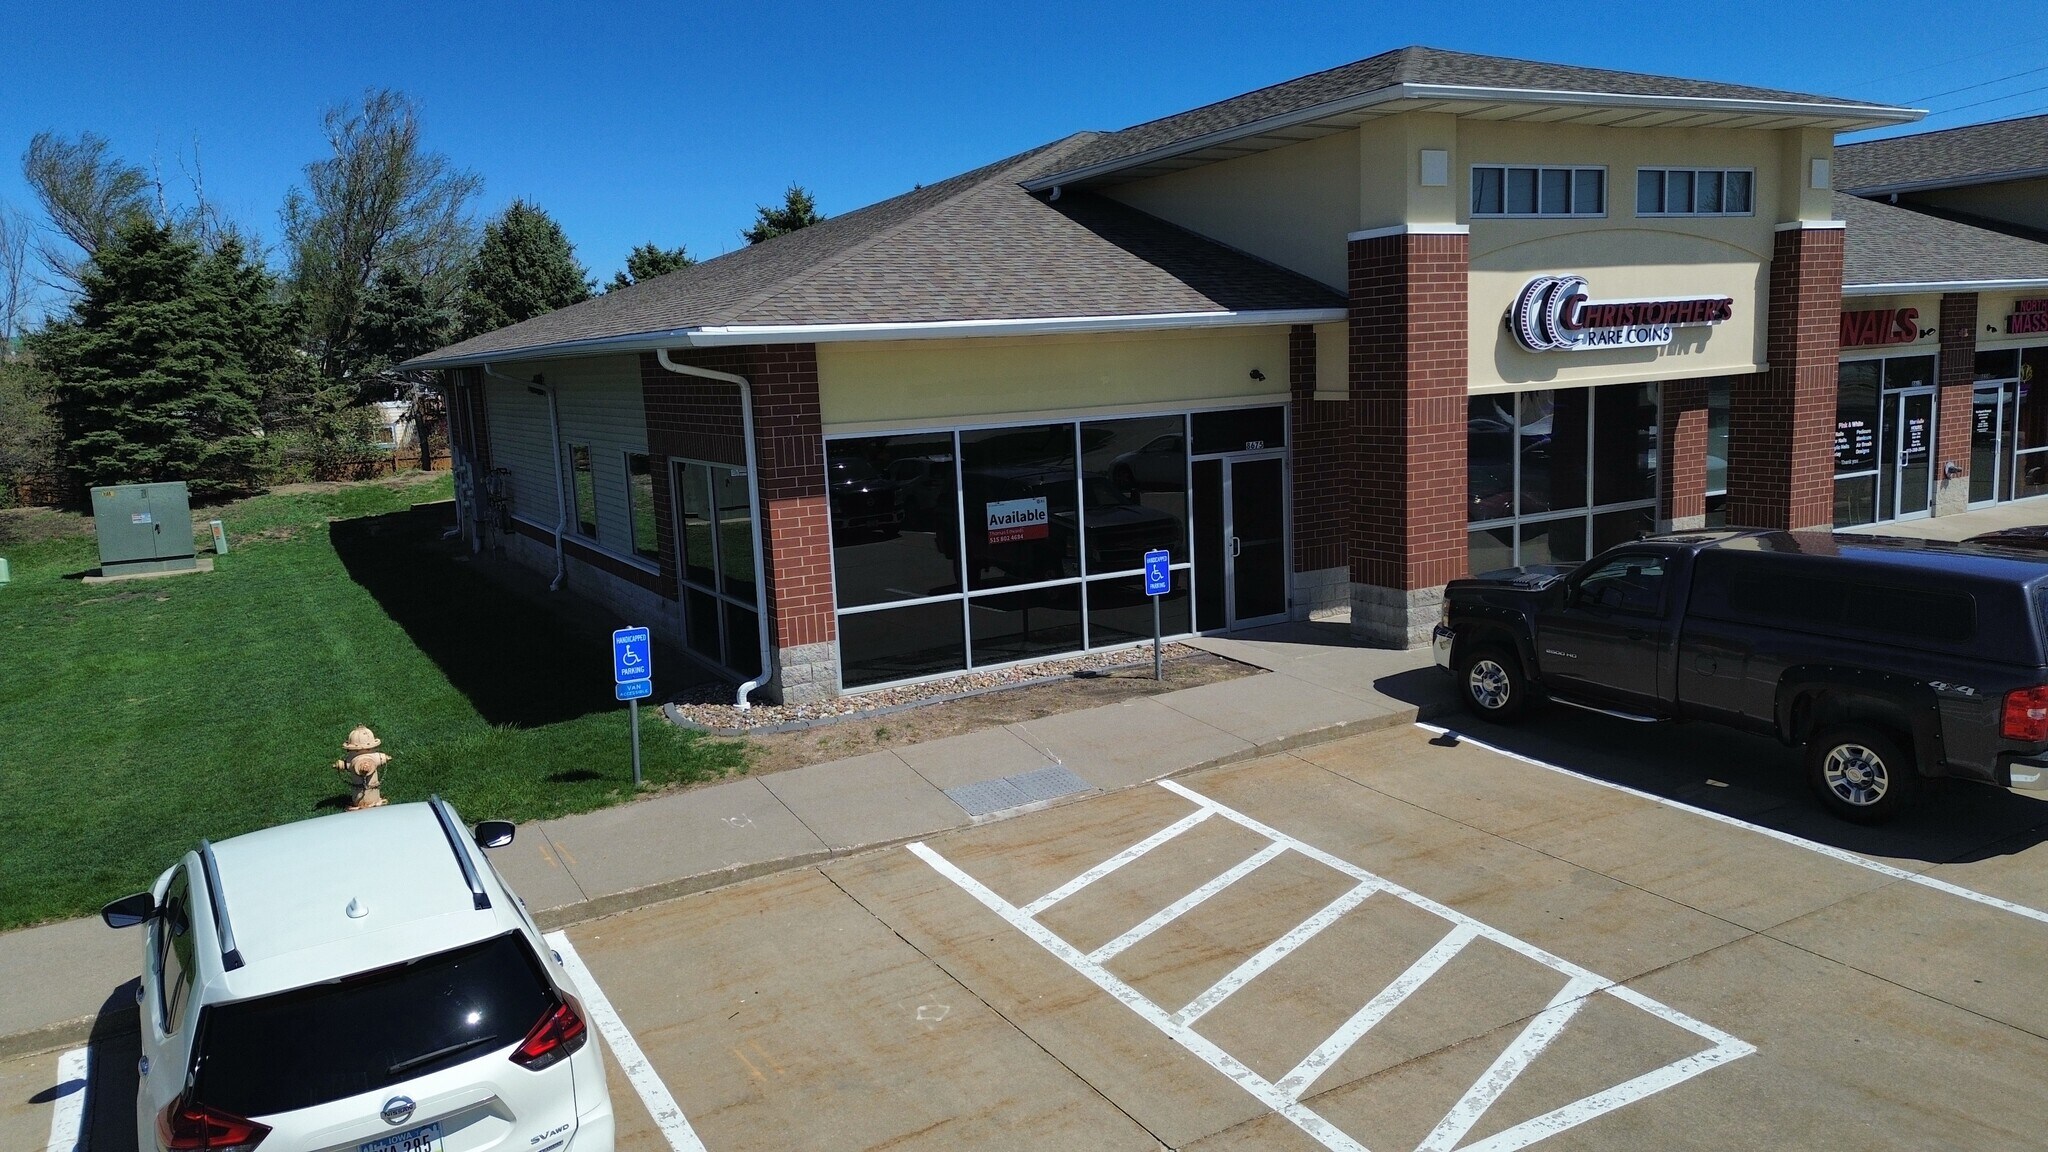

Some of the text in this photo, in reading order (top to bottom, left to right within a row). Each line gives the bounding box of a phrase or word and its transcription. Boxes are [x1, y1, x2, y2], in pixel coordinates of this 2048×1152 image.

[1562, 293, 1734, 330] CHRISTOPHER'S
[1841, 308, 1919, 346] NAILS
[1588, 327, 1671, 346] RARE COINS
[989, 509, 1046, 526] Available
[616, 634, 647, 644] HANDICAPPED
[621, 666, 645, 675] PARKING
[384, 1105, 413, 1117] NISSAN
[388, 1131, 413, 1145] IOWA
[530, 1123, 570, 1145] SV AWD
